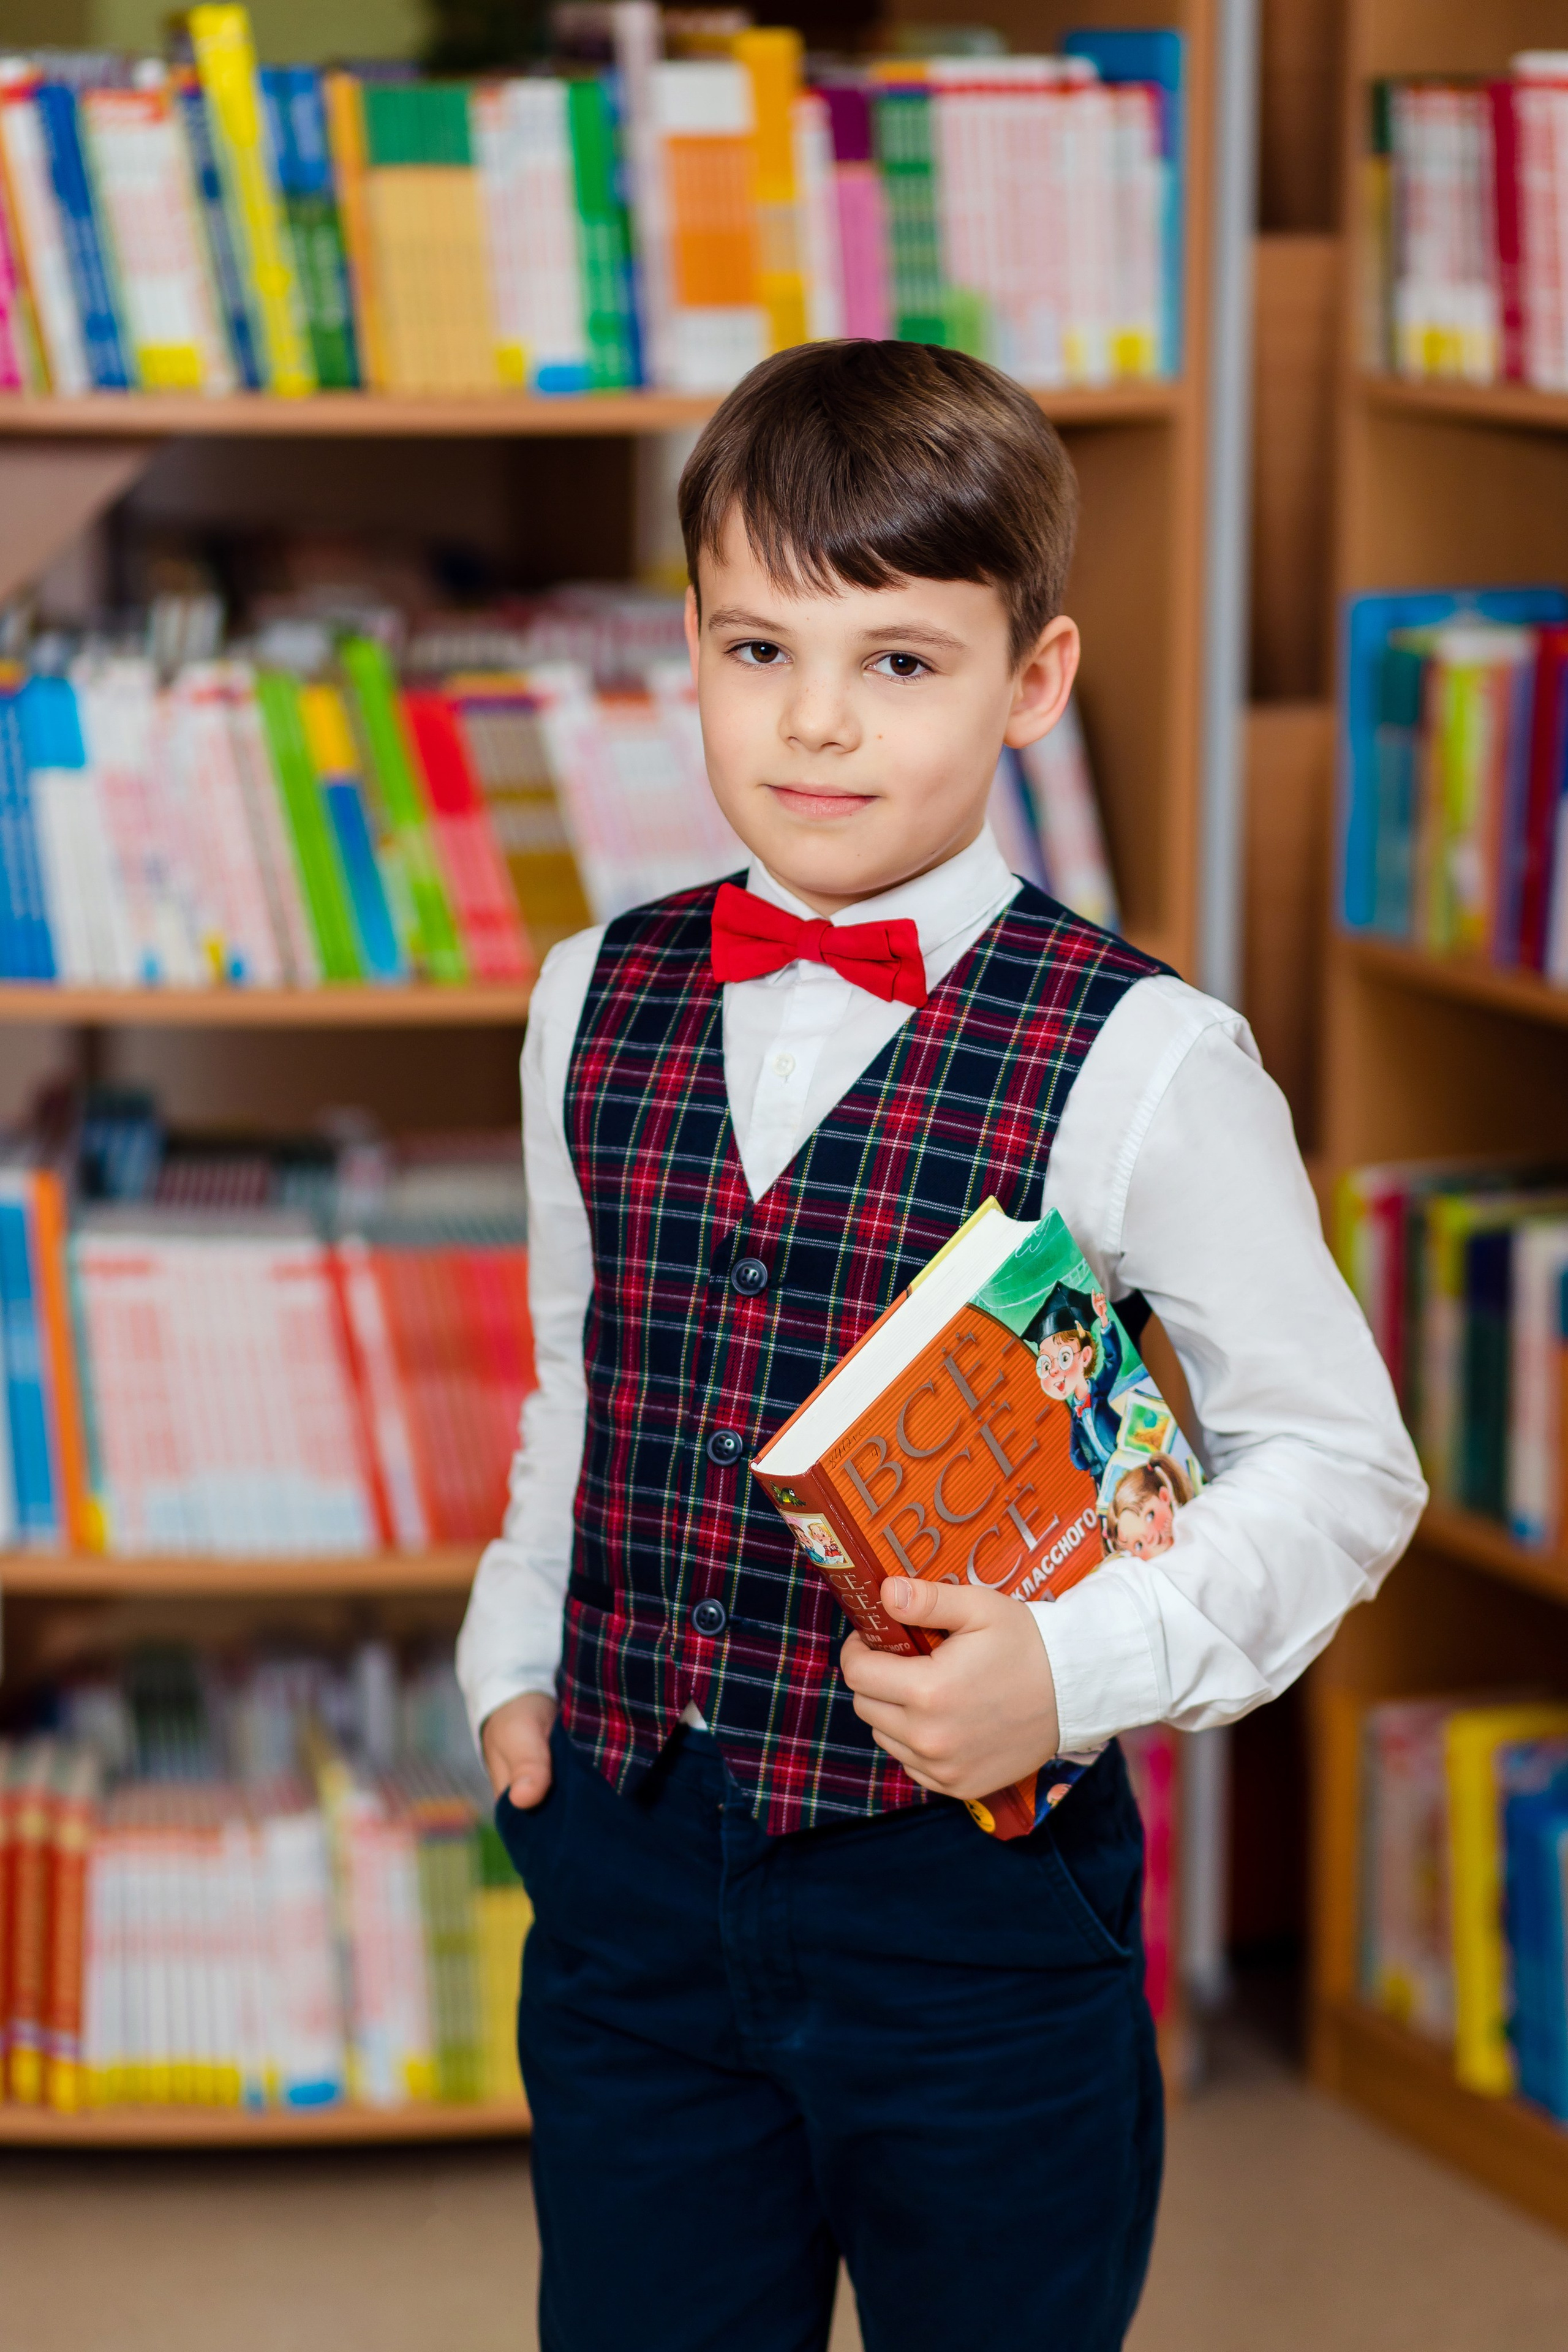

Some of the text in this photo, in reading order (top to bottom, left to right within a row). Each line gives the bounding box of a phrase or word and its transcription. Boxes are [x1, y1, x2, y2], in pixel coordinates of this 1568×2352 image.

[838, 1331, 1016, 1521] ВСЁ-
[878, 1400, 1050, 1578] ВСЁ-
[938, 1482, 1060, 1589] СЁ
[829, 1572, 872, 1590] СЁ-
[842, 1593, 882, 1610] СЁ-
[854, 1613, 889, 1630] СЁ
